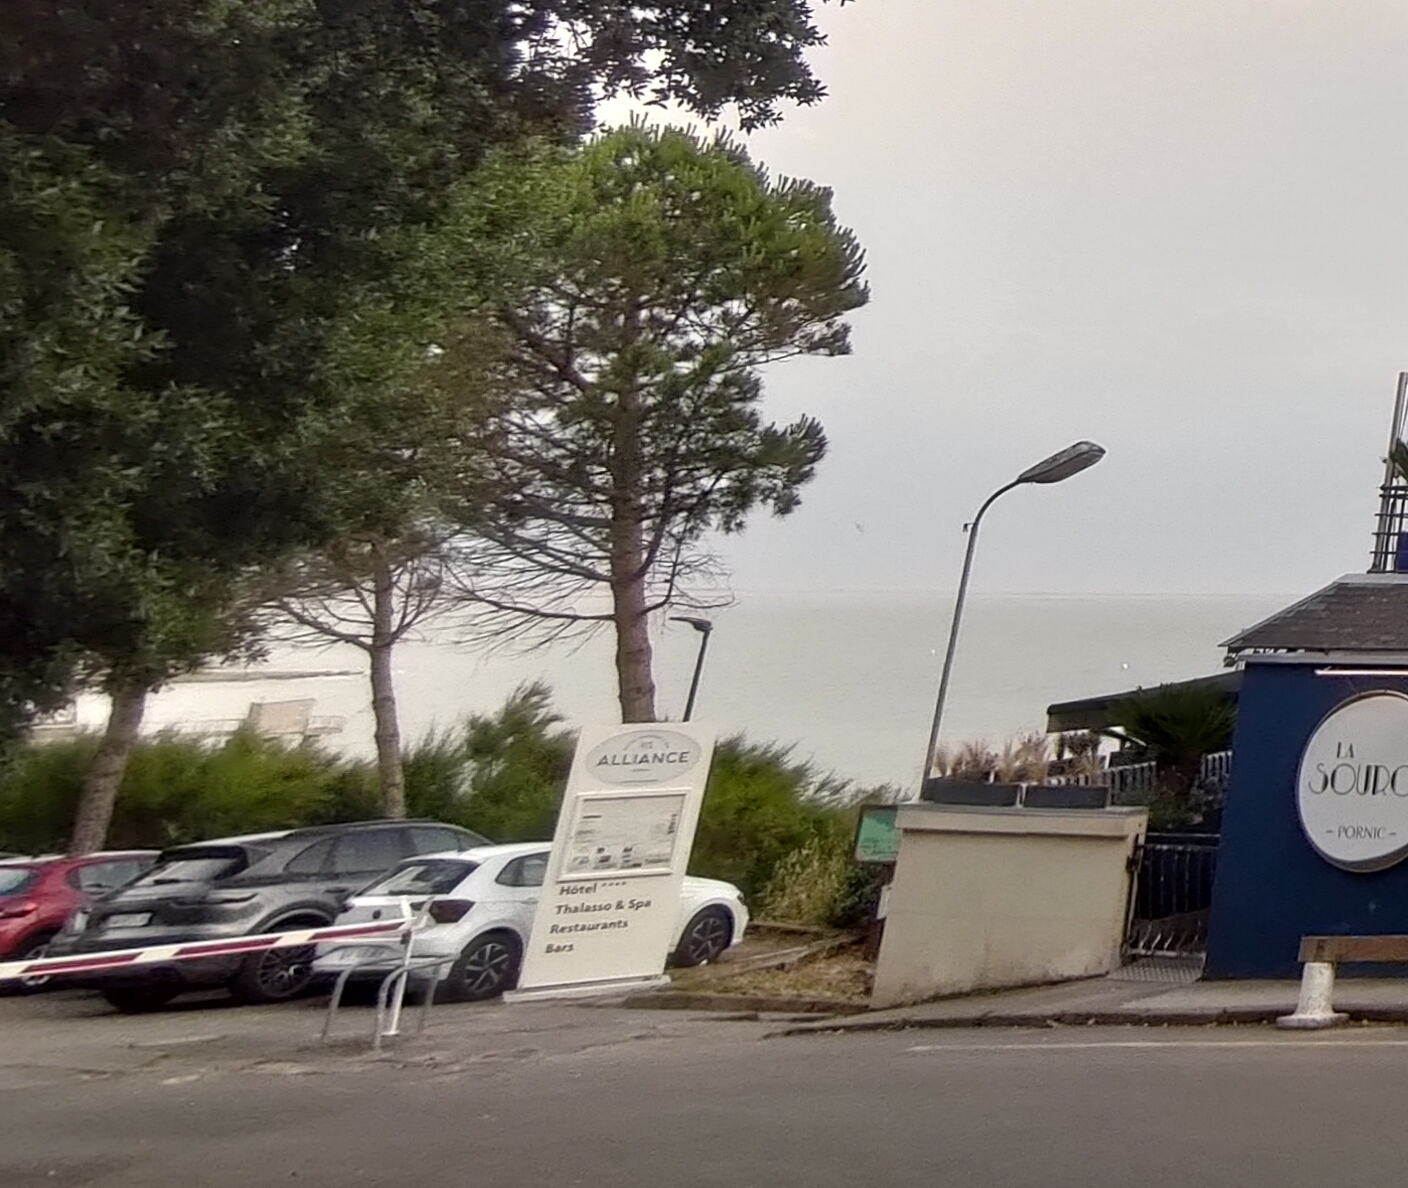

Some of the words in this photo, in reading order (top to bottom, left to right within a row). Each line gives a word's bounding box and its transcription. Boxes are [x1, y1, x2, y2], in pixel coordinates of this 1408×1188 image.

[1336, 741, 1355, 760] LA
[597, 751, 691, 766] ALLIANCE
[1337, 825, 1387, 841] PORNIC
[555, 902, 612, 914] Thalasso
[615, 900, 624, 910] &
[628, 899, 652, 911] Spa
[549, 920, 629, 934] Restaurants
[544, 943, 574, 954] Bars
